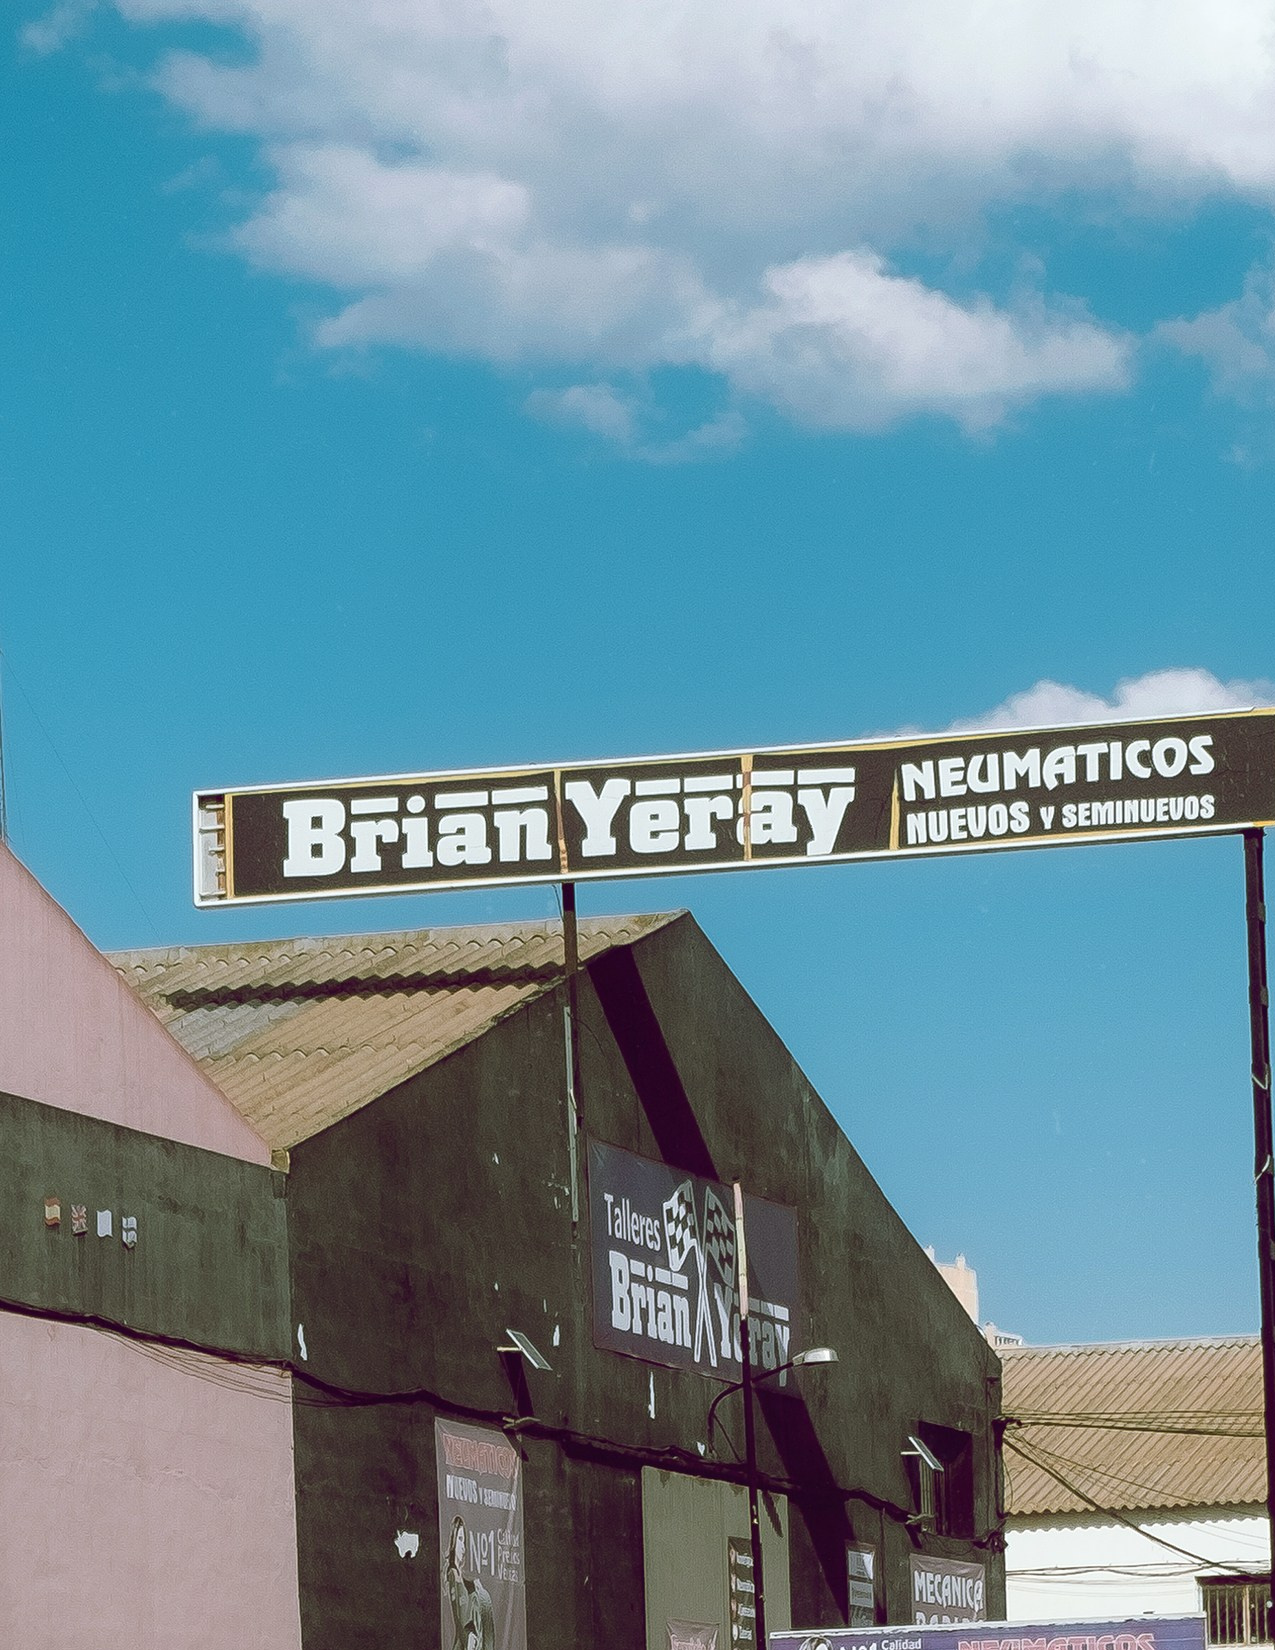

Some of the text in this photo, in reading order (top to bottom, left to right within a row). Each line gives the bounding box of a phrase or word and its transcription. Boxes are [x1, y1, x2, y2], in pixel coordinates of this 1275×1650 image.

[901, 735, 1215, 801] NEUMATICOS
[283, 767, 856, 877] Brian Yeray
[906, 801, 1031, 845] NUEVOS
[1062, 794, 1215, 828] SEMINUEVOS
[604, 1192, 661, 1251] Talleres
[609, 1250, 692, 1349] Brian
[914, 1570, 983, 1612] MECANICA
